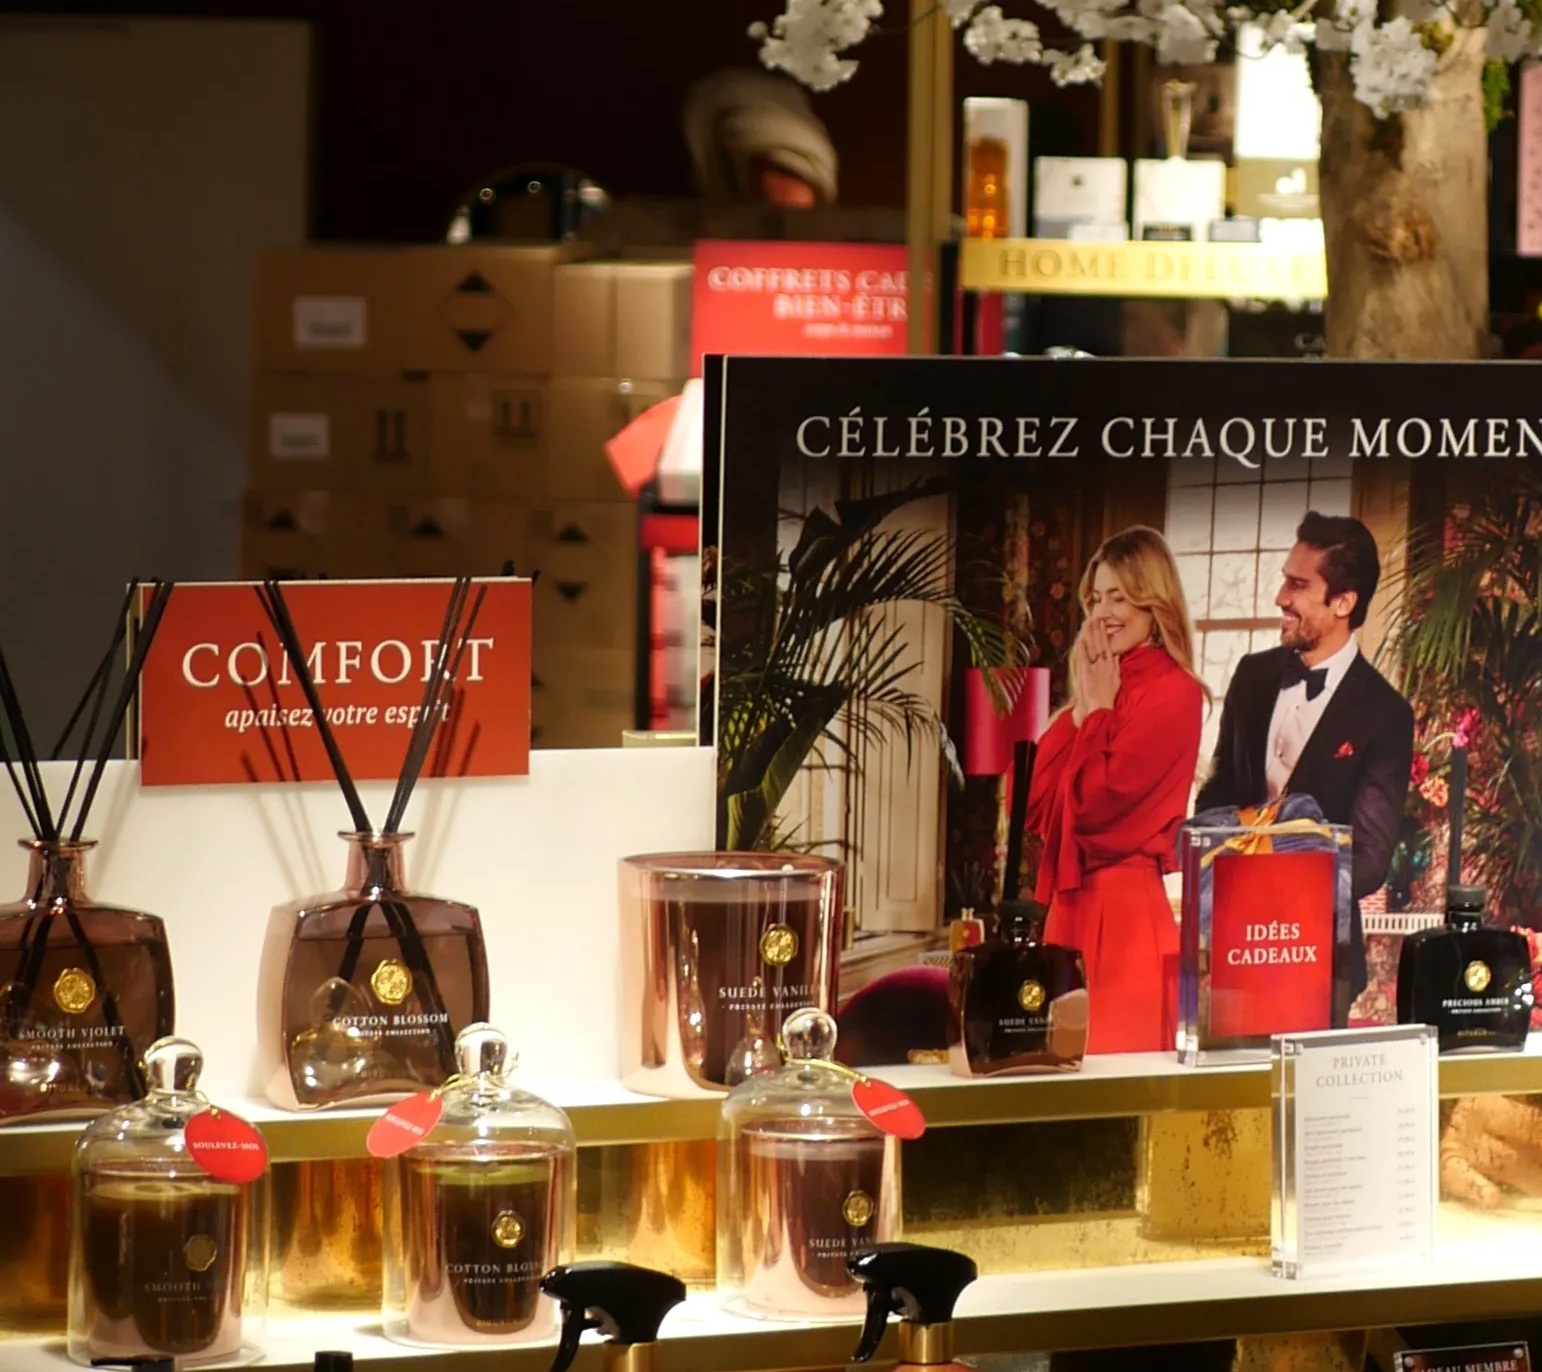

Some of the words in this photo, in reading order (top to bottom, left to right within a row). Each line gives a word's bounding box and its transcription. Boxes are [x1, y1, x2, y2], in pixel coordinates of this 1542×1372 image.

[1000, 248, 1127, 279] HOME
[796, 406, 1080, 458] CÉLÉBREZ
[1101, 416, 1329, 469] CHAQUE
[182, 637, 495, 688] COMFORT
[224, 703, 314, 733] apaisez
[1246, 919, 1301, 942] IDÉES
[1227, 945, 1318, 966] CADEAUX
[718, 985, 766, 999] SUEDE
[332, 1014, 389, 1028] COTTON
[393, 1012, 449, 1026] BLOSSOM
[18, 1028, 76, 1041] SMOOTH
[80, 1024, 126, 1038] VIOLET
[1333, 1053, 1388, 1069] PRIVATE
[1316, 1069, 1403, 1088] COLLECTION
[445, 1262, 501, 1275] COTTON
